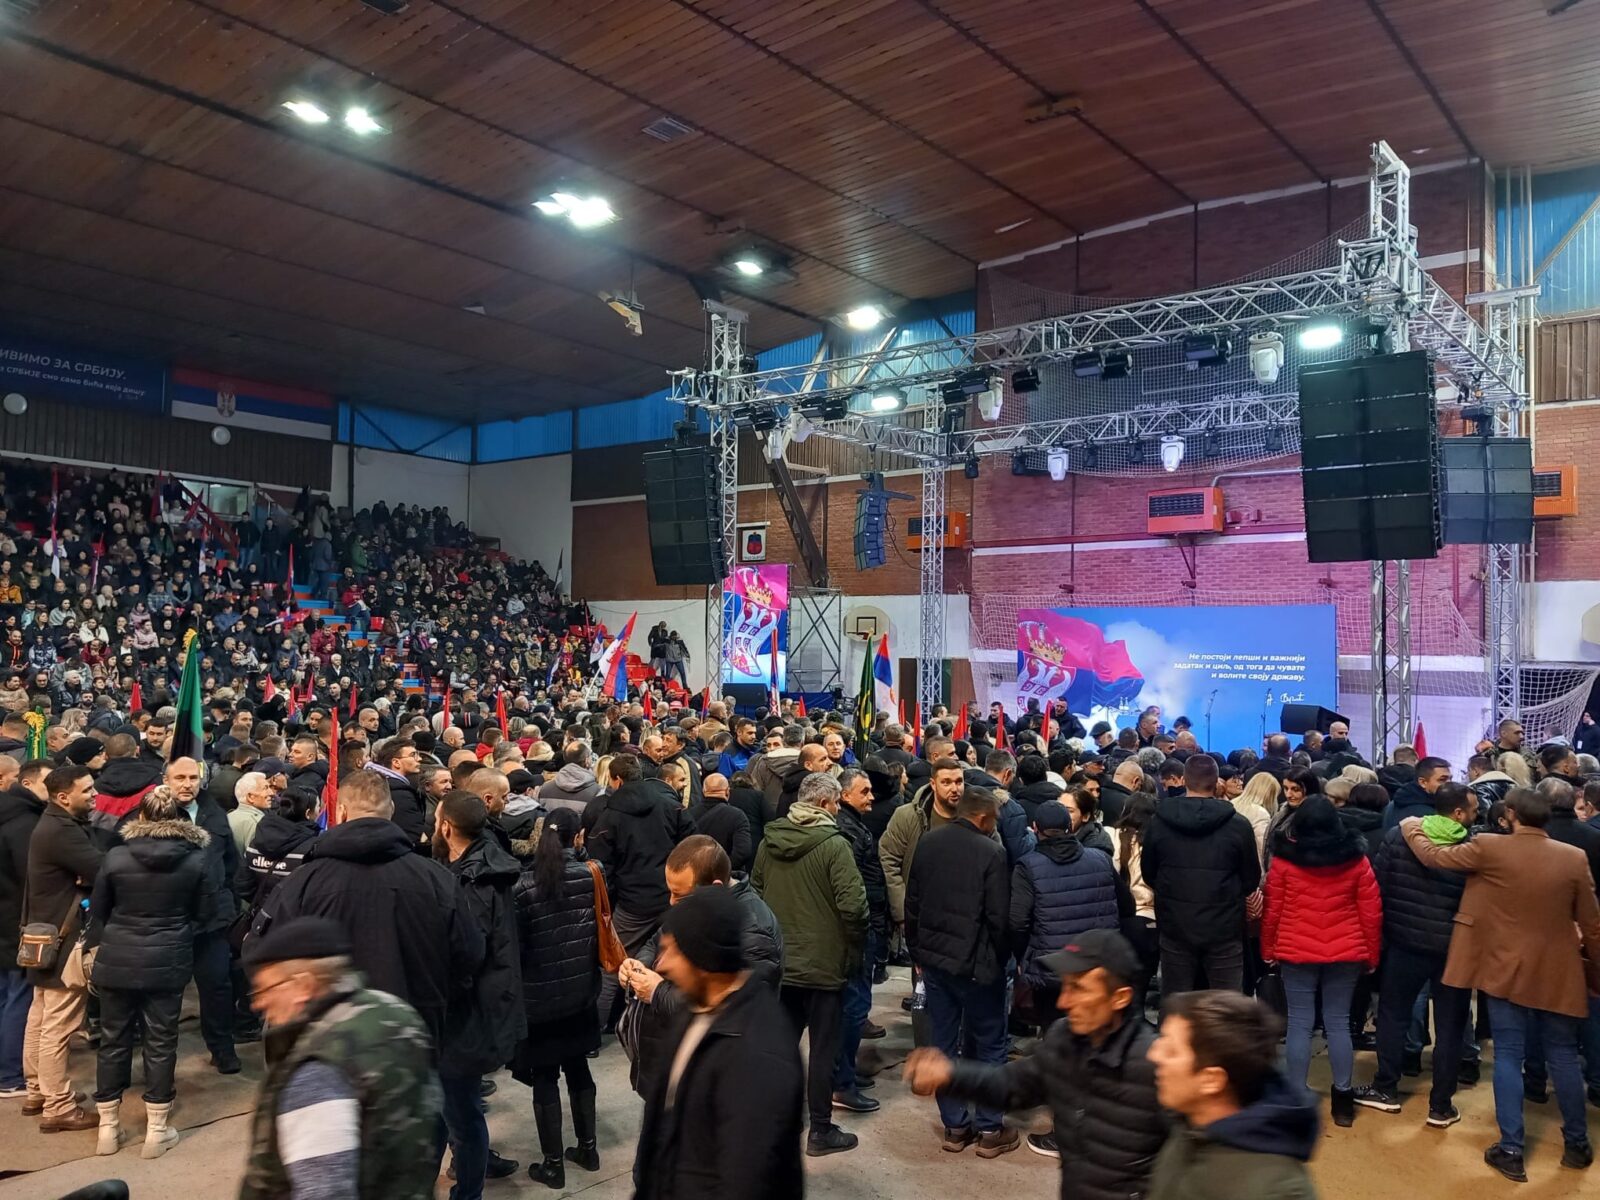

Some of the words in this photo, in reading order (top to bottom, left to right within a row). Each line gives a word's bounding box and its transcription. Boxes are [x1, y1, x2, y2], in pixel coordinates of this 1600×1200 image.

[53, 358, 72, 370] ЗА
[74, 362, 127, 380] СРБИЈУ.
[6, 367, 42, 378] СРБИЈЕ
[43, 374, 60, 382] смо
[61, 377, 83, 386] само
[83, 379, 104, 389] бића
[1201, 653, 1231, 662] постоји
[1270, 654, 1305, 663] важнији
[1212, 663, 1232, 671] циљ,
[1248, 672, 1270, 681] своју
[1271, 674, 1305, 682] државу.
